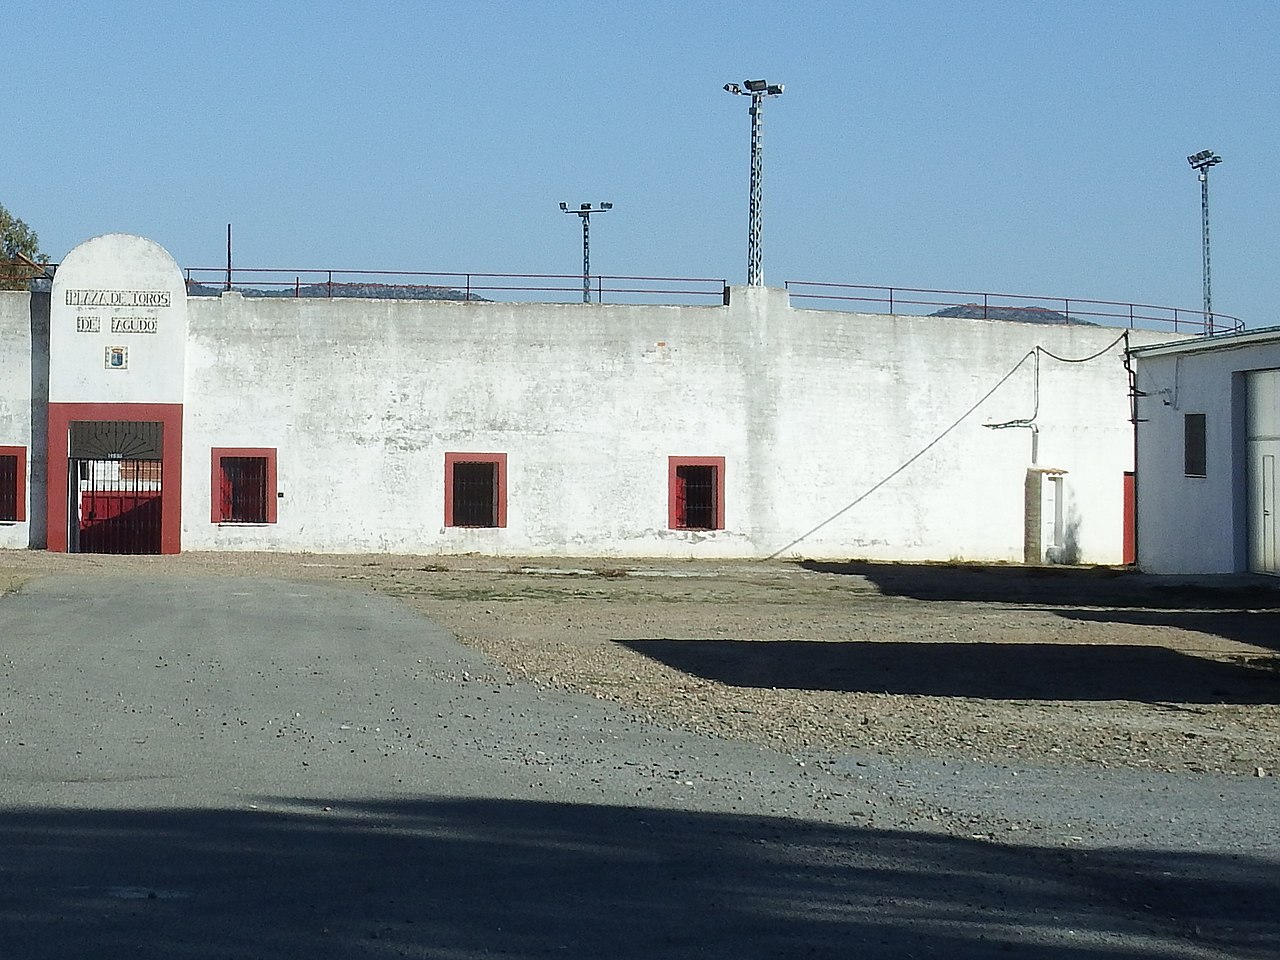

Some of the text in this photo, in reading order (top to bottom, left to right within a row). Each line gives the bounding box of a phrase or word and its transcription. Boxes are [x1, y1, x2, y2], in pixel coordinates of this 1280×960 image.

[69, 292, 169, 304] PLAZA DE TOROS
[81, 319, 155, 331] DE AGUDO
